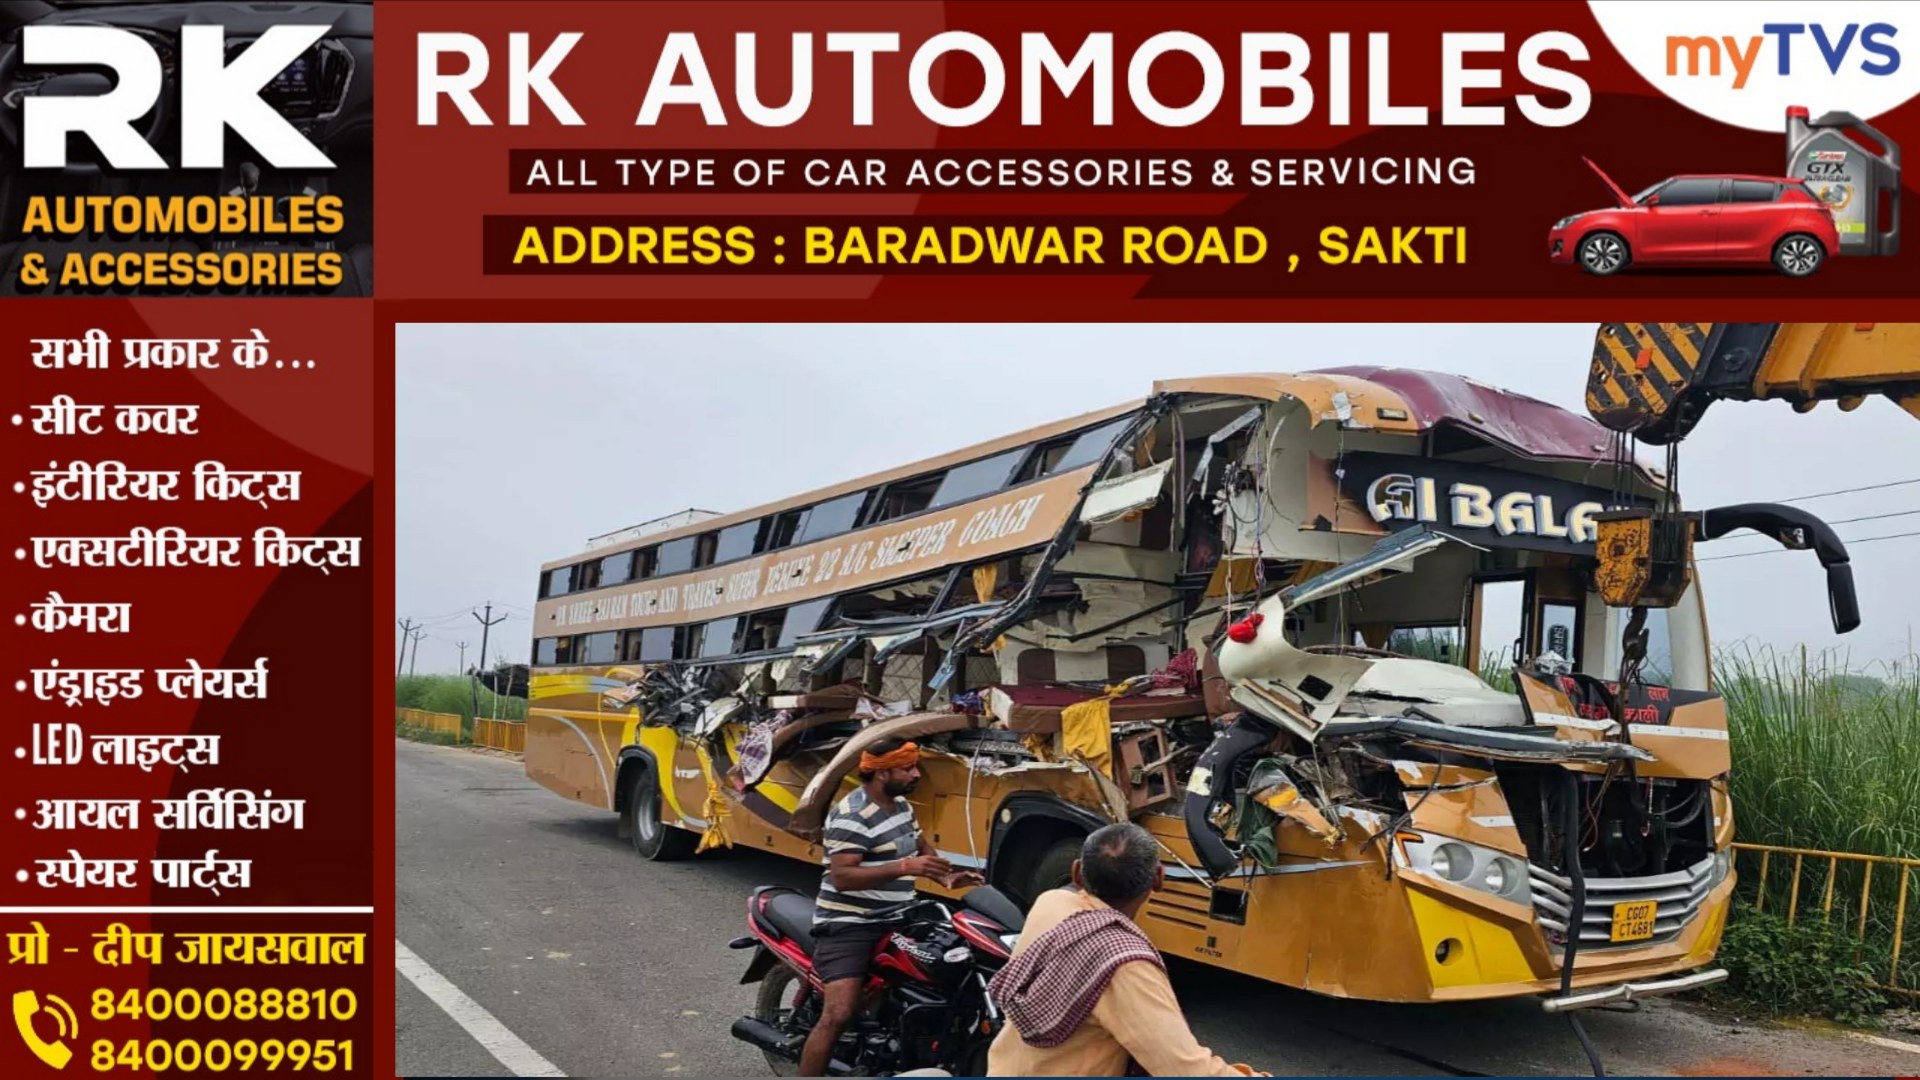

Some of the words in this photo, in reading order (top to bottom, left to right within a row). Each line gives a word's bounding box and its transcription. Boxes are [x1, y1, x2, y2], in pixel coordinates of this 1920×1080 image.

[1807, 162, 1846, 174] GTX
[1450, 482, 1632, 543] BALA
[658, 586, 678, 613] AND
[682, 578, 724, 611] TRAVELS
[726, 568, 760, 603] SUPER
[762, 554, 816, 595] DELUXE
[869, 519, 957, 570] SLEEPER
[957, 492, 1046, 548] COACH
[1626, 905, 1650, 920] CG07
